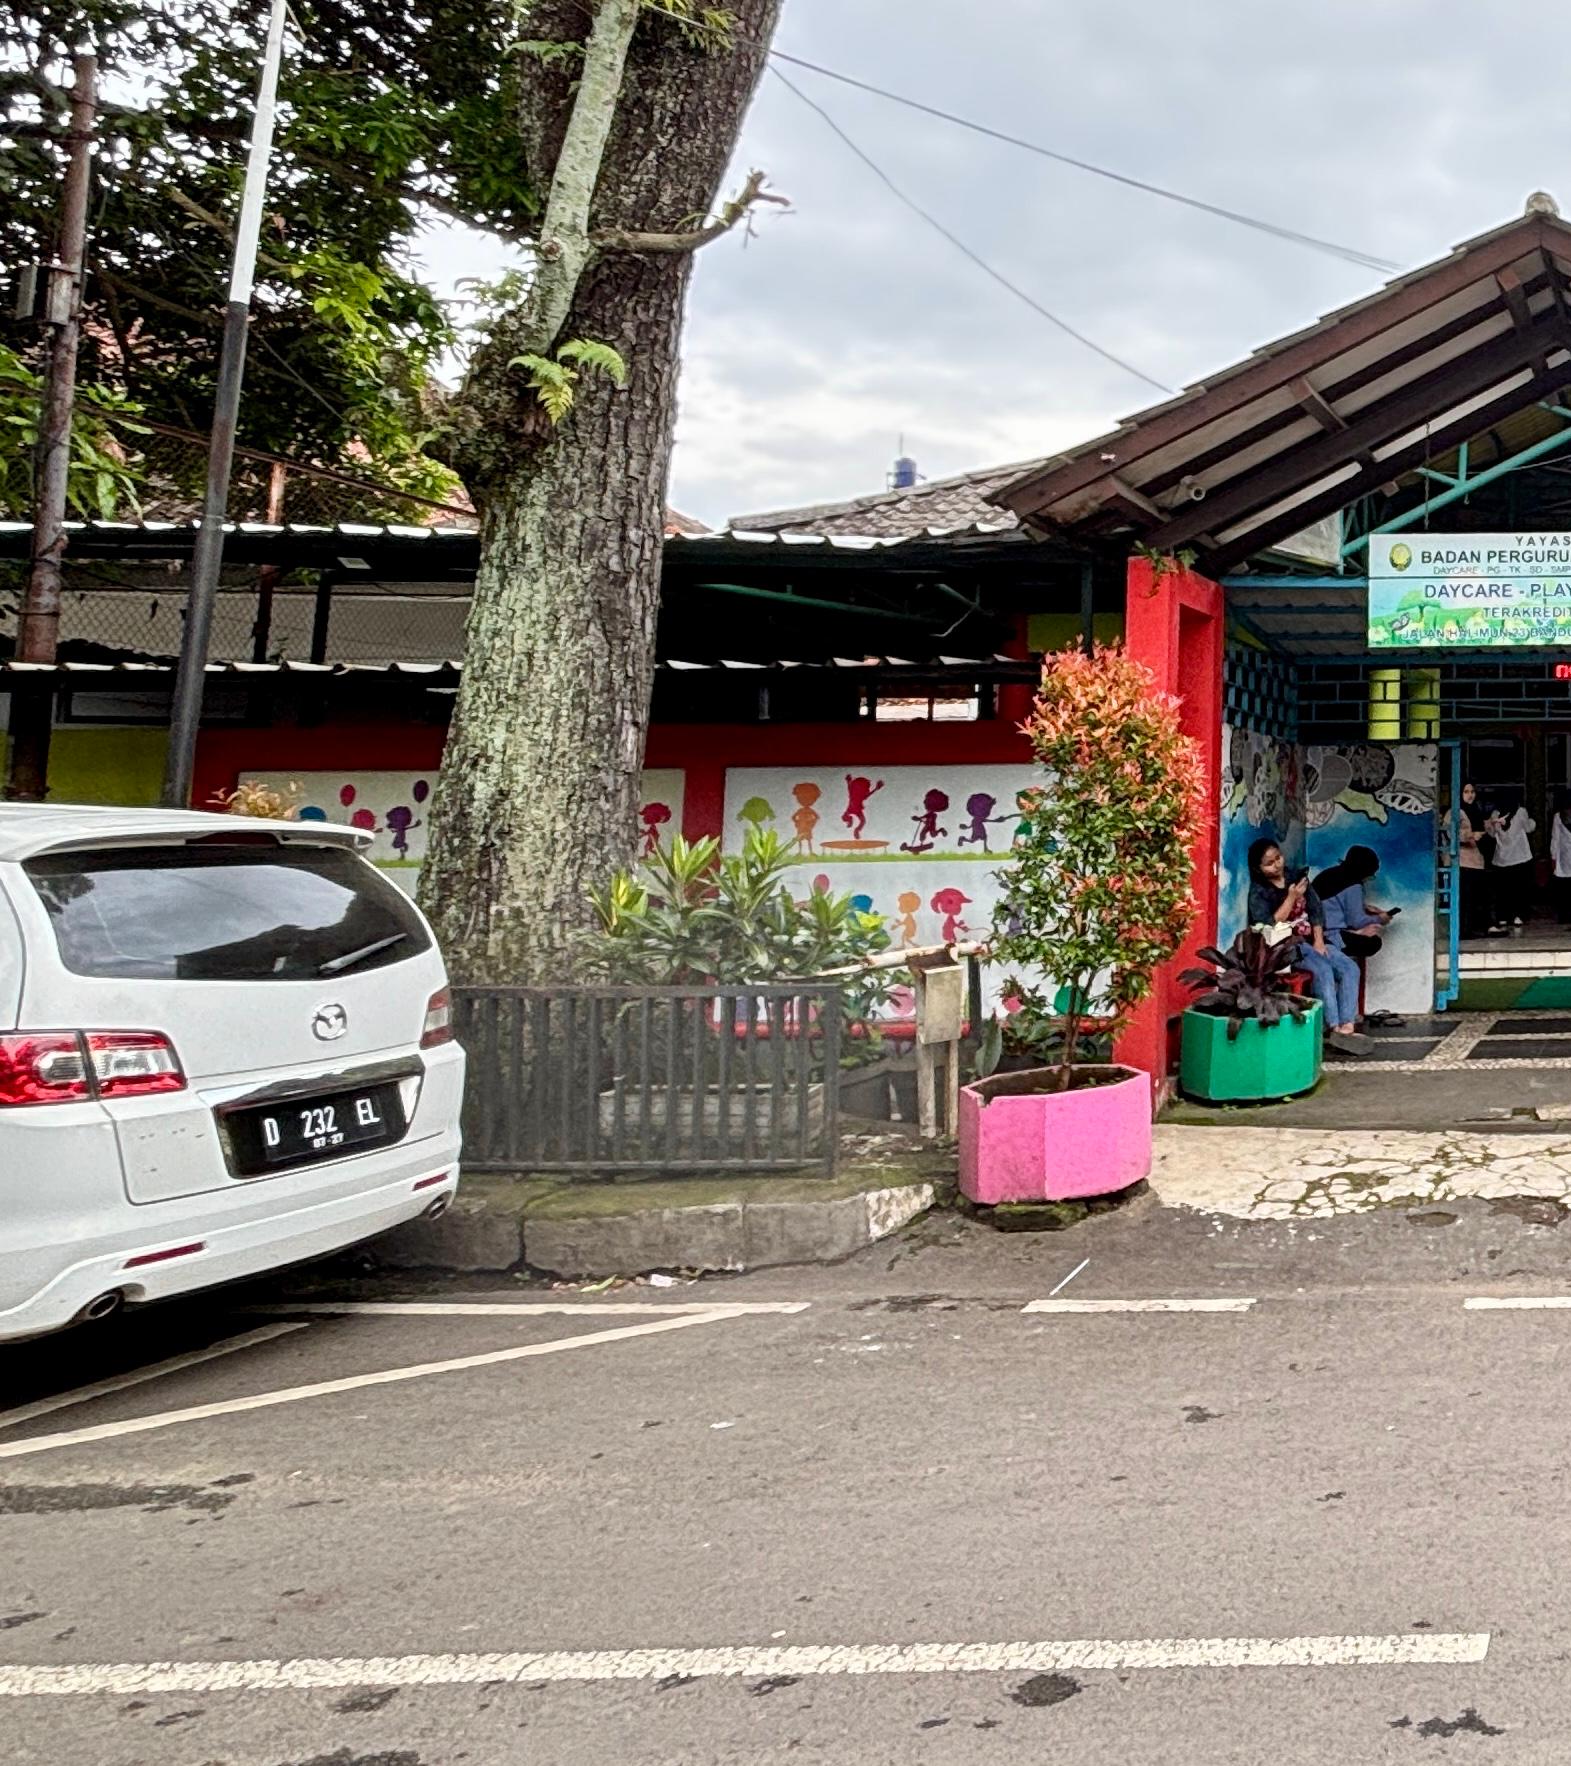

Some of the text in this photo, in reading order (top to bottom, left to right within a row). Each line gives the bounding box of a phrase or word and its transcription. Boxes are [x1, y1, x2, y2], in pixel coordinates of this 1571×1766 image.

[1421, 550, 1482, 564] BADAN
[1433, 565, 1479, 575] DAYCARE
[1487, 565, 1501, 575] PG
[1508, 565, 1521, 574] TK
[1424, 583, 1513, 598] DAYCARE
[1403, 628, 1444, 639] JALAN
[264, 1097, 381, 1146] D 232 EL
